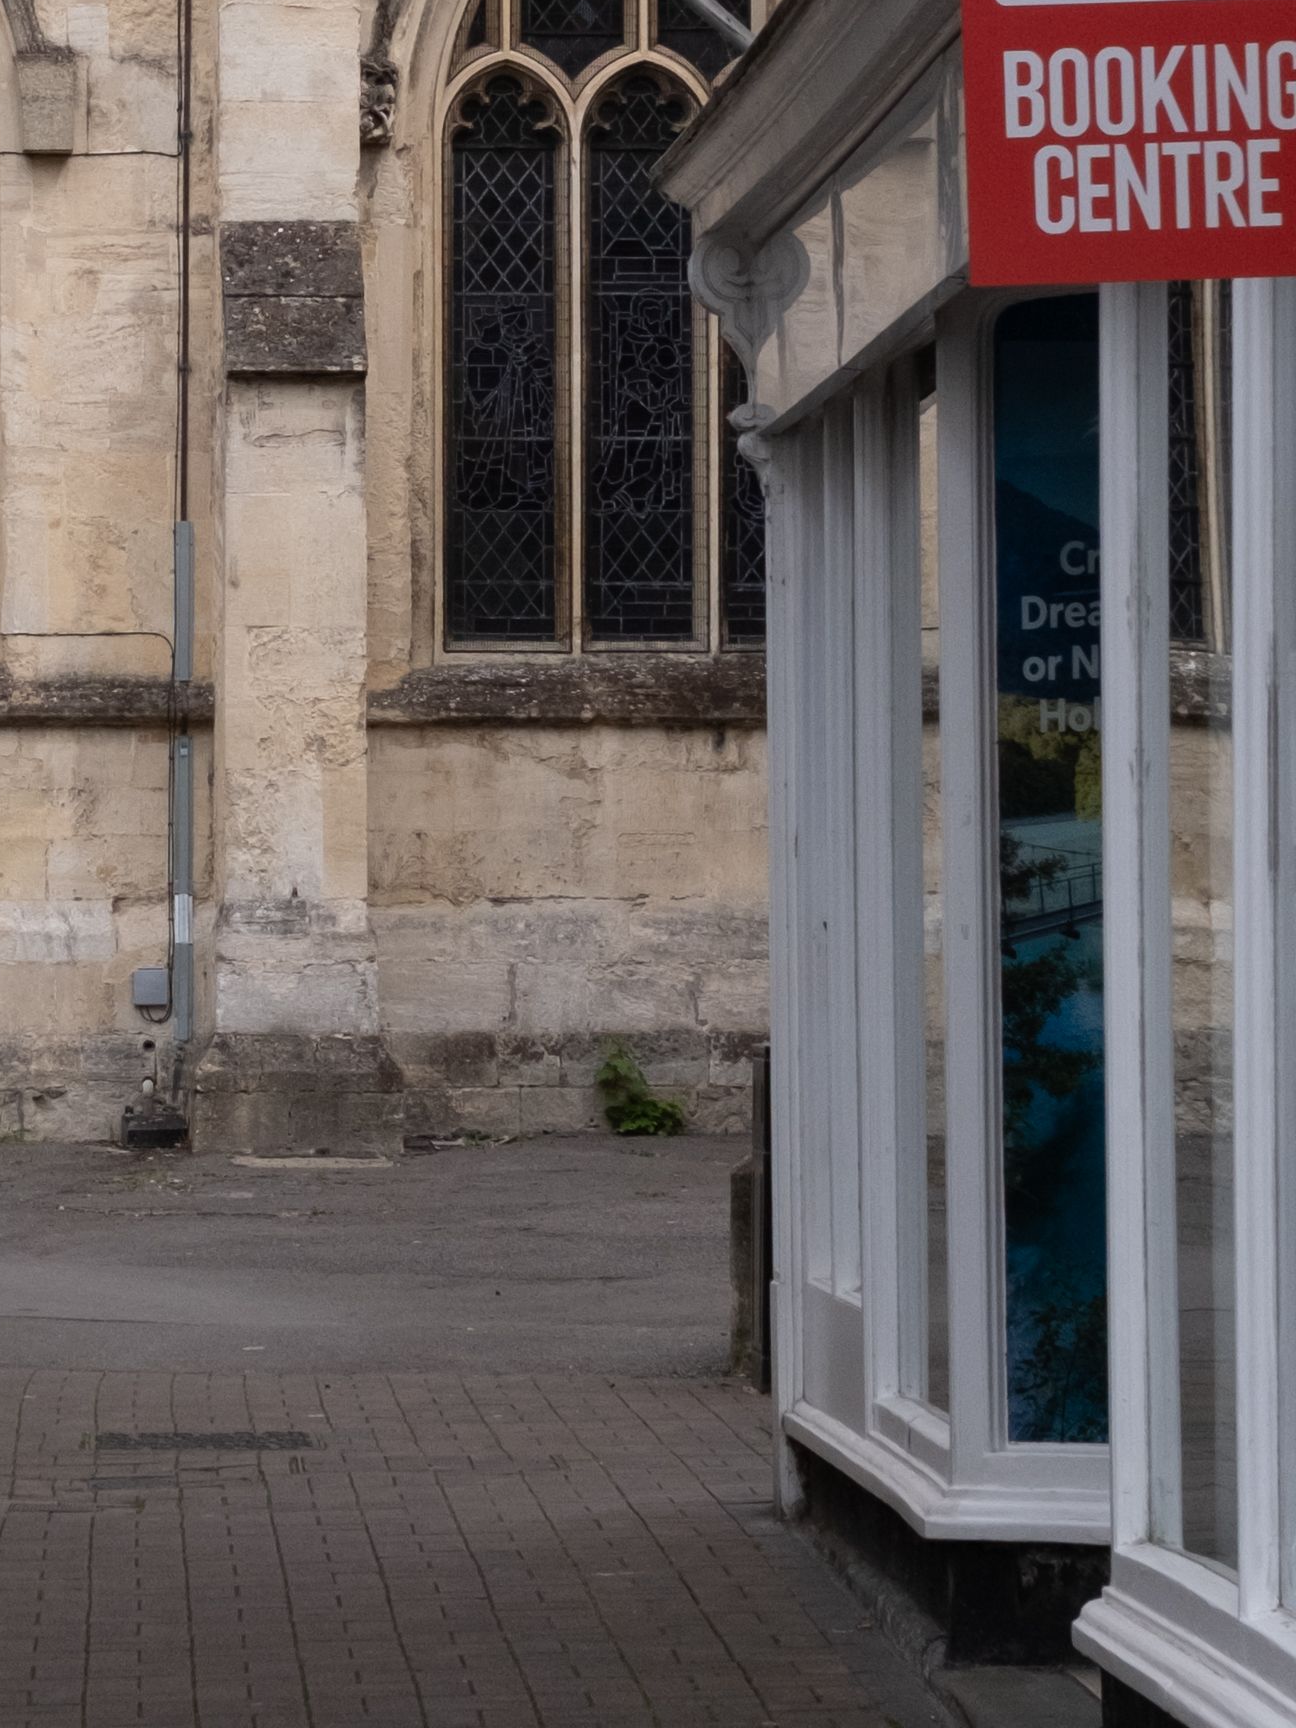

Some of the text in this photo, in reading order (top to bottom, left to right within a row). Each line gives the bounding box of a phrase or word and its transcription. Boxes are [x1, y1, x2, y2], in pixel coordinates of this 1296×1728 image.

[1003, 40, 1296, 139] BOOKING
[1033, 138, 1284, 235] CENTRE
[1022, 654, 1063, 682] or
